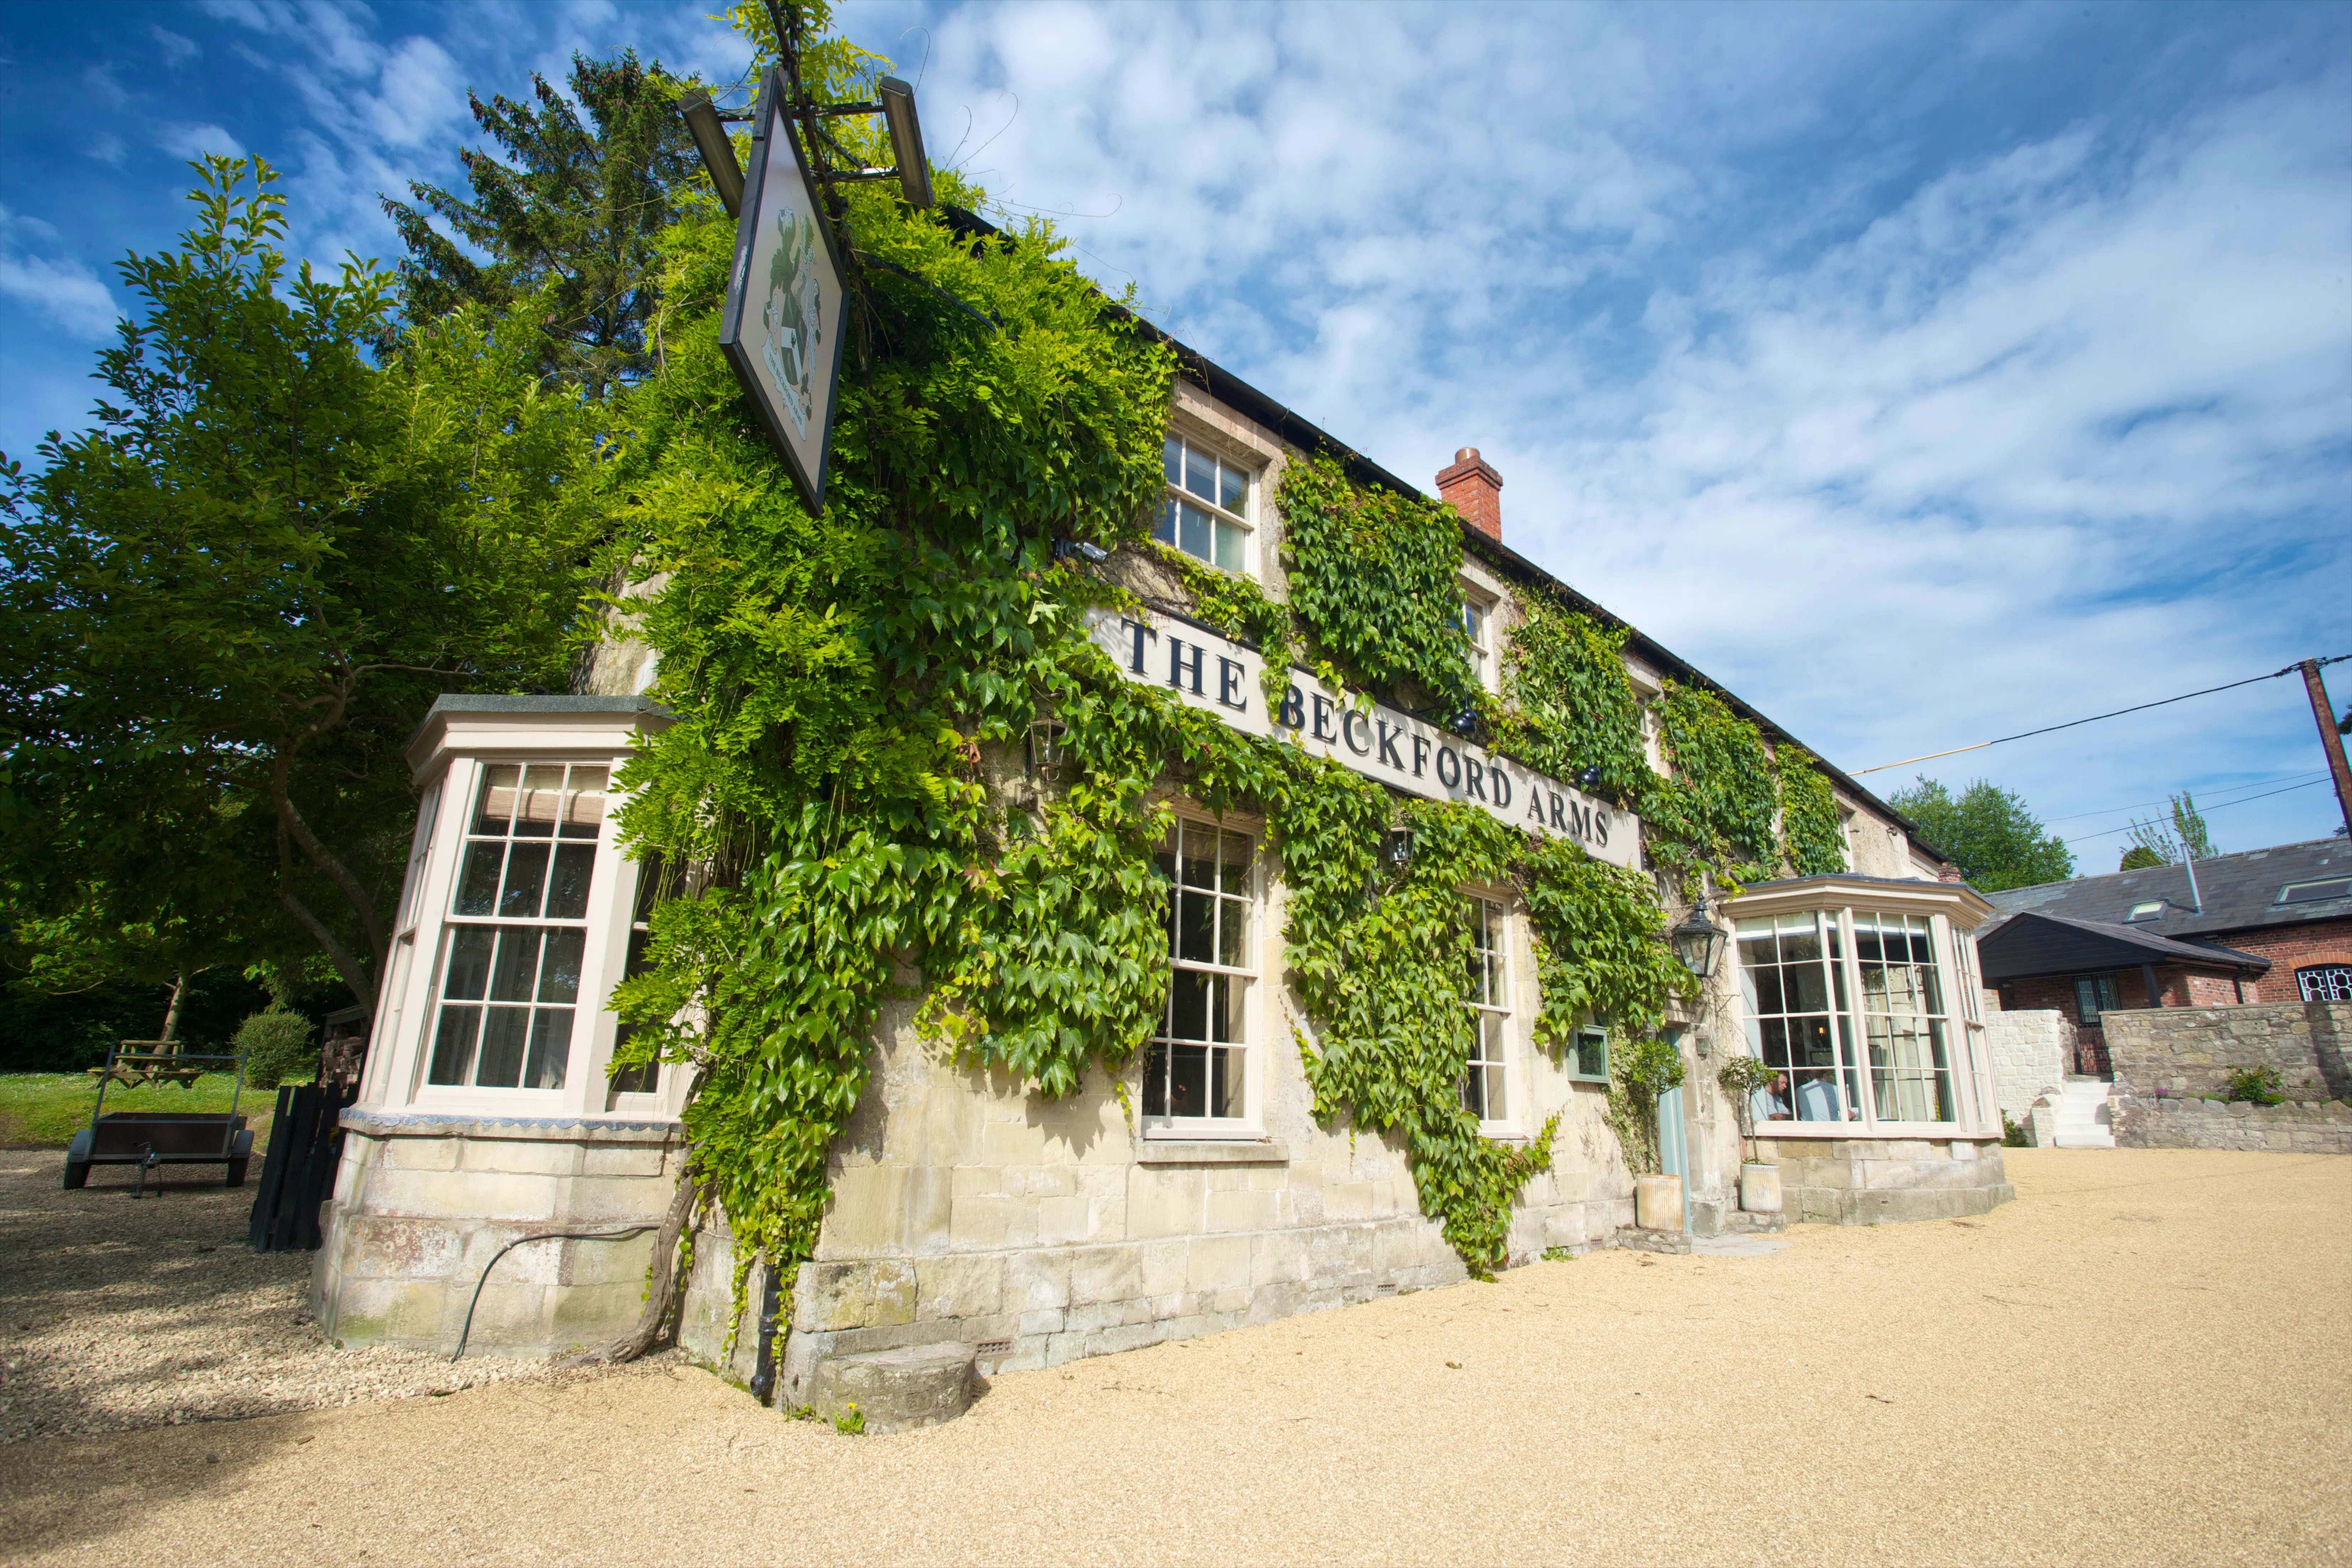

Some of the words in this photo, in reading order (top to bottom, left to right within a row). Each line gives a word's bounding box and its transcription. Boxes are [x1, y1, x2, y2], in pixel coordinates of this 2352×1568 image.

[776, 367, 793, 406] BECKFORD
[793, 405, 802, 425] ARMS
[1121, 617, 1247, 711] THE
[1279, 682, 1512, 808] BECKFORD
[1527, 784, 1608, 847] ARMS
